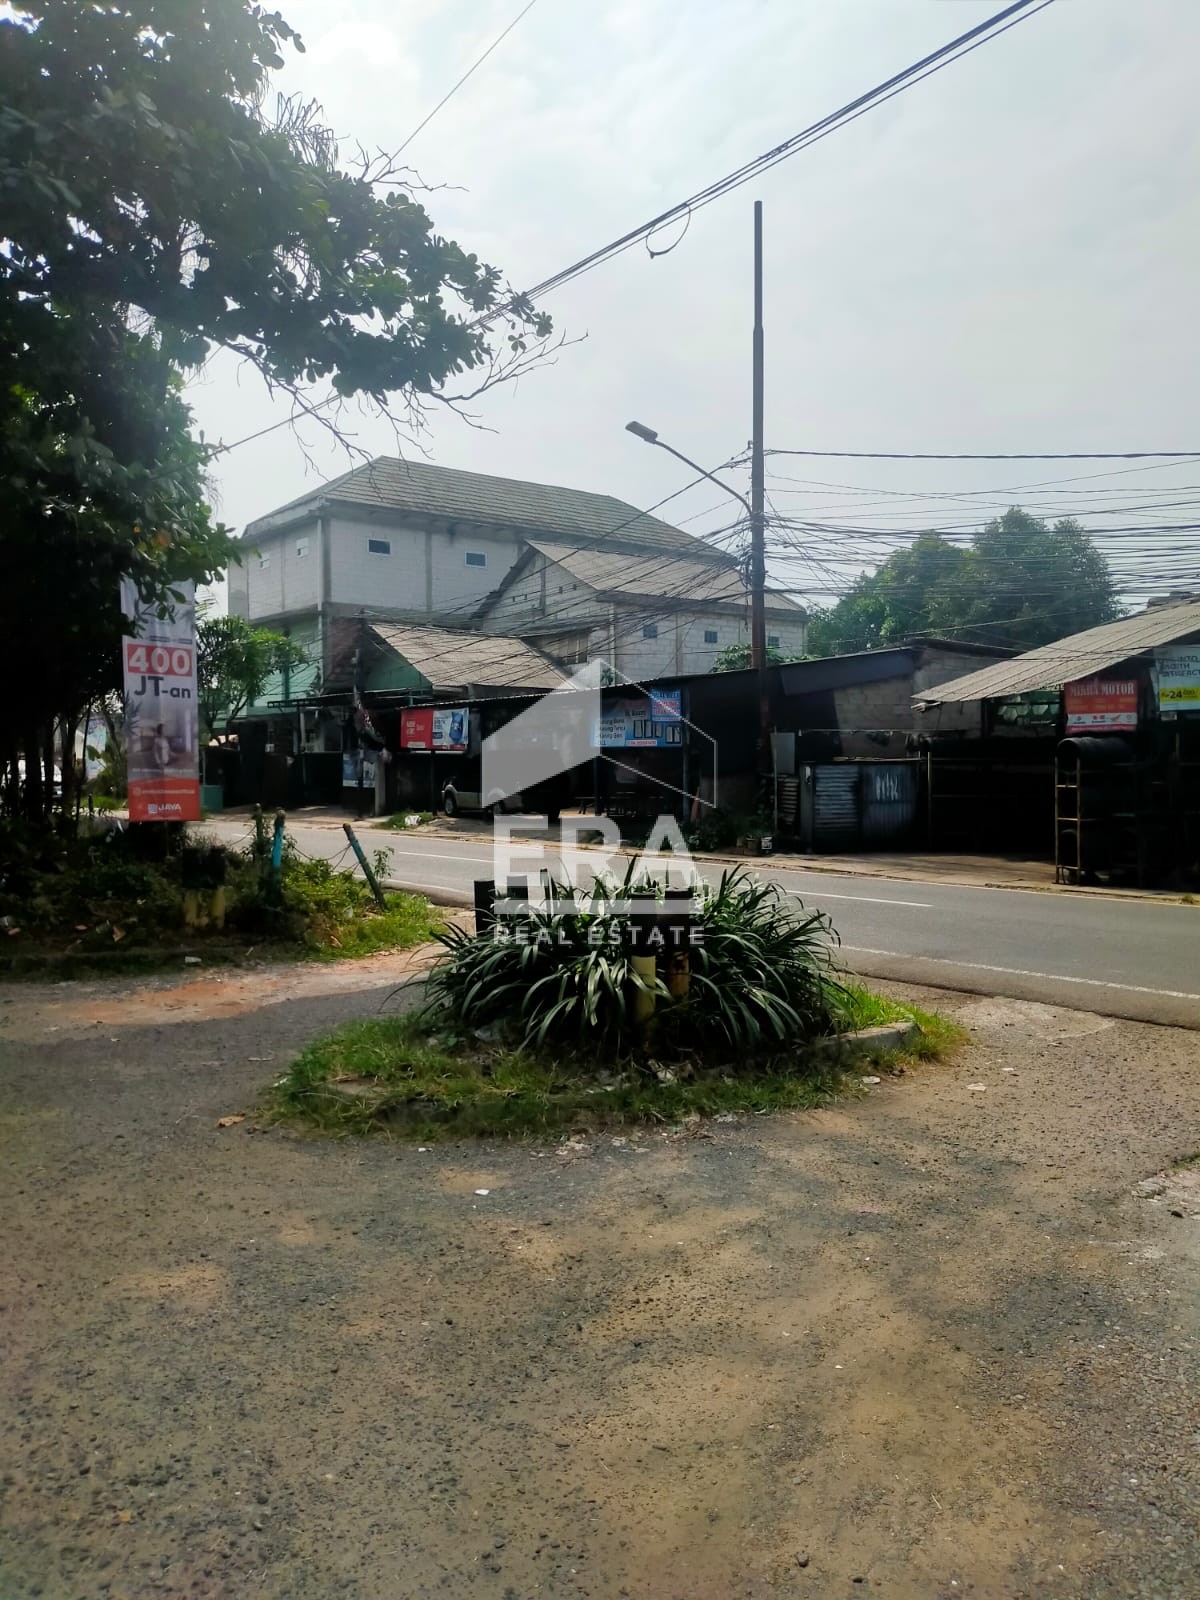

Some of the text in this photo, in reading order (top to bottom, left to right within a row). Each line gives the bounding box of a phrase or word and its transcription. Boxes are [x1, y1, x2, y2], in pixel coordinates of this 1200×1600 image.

[129, 647, 190, 675] 400
[134, 675, 191, 699] JT-an
[1102, 682, 1134, 696] MOTOR
